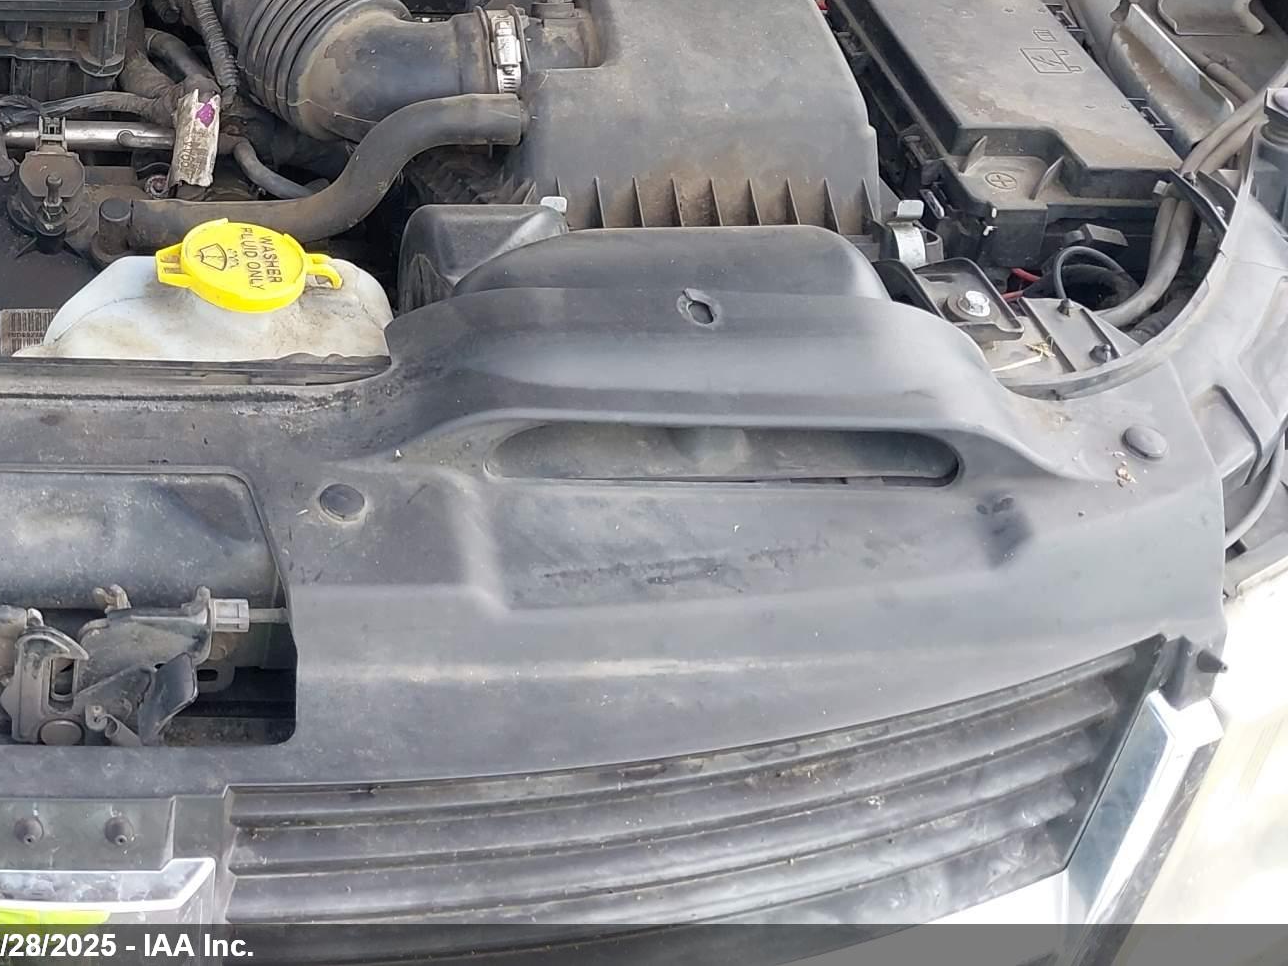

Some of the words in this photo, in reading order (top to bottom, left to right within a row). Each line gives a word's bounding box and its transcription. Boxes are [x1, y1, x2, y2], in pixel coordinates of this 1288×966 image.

[240, 227, 258, 259] FLUID
[259, 236, 283, 283] WASHER
[247, 261, 266, 291] ONLY
